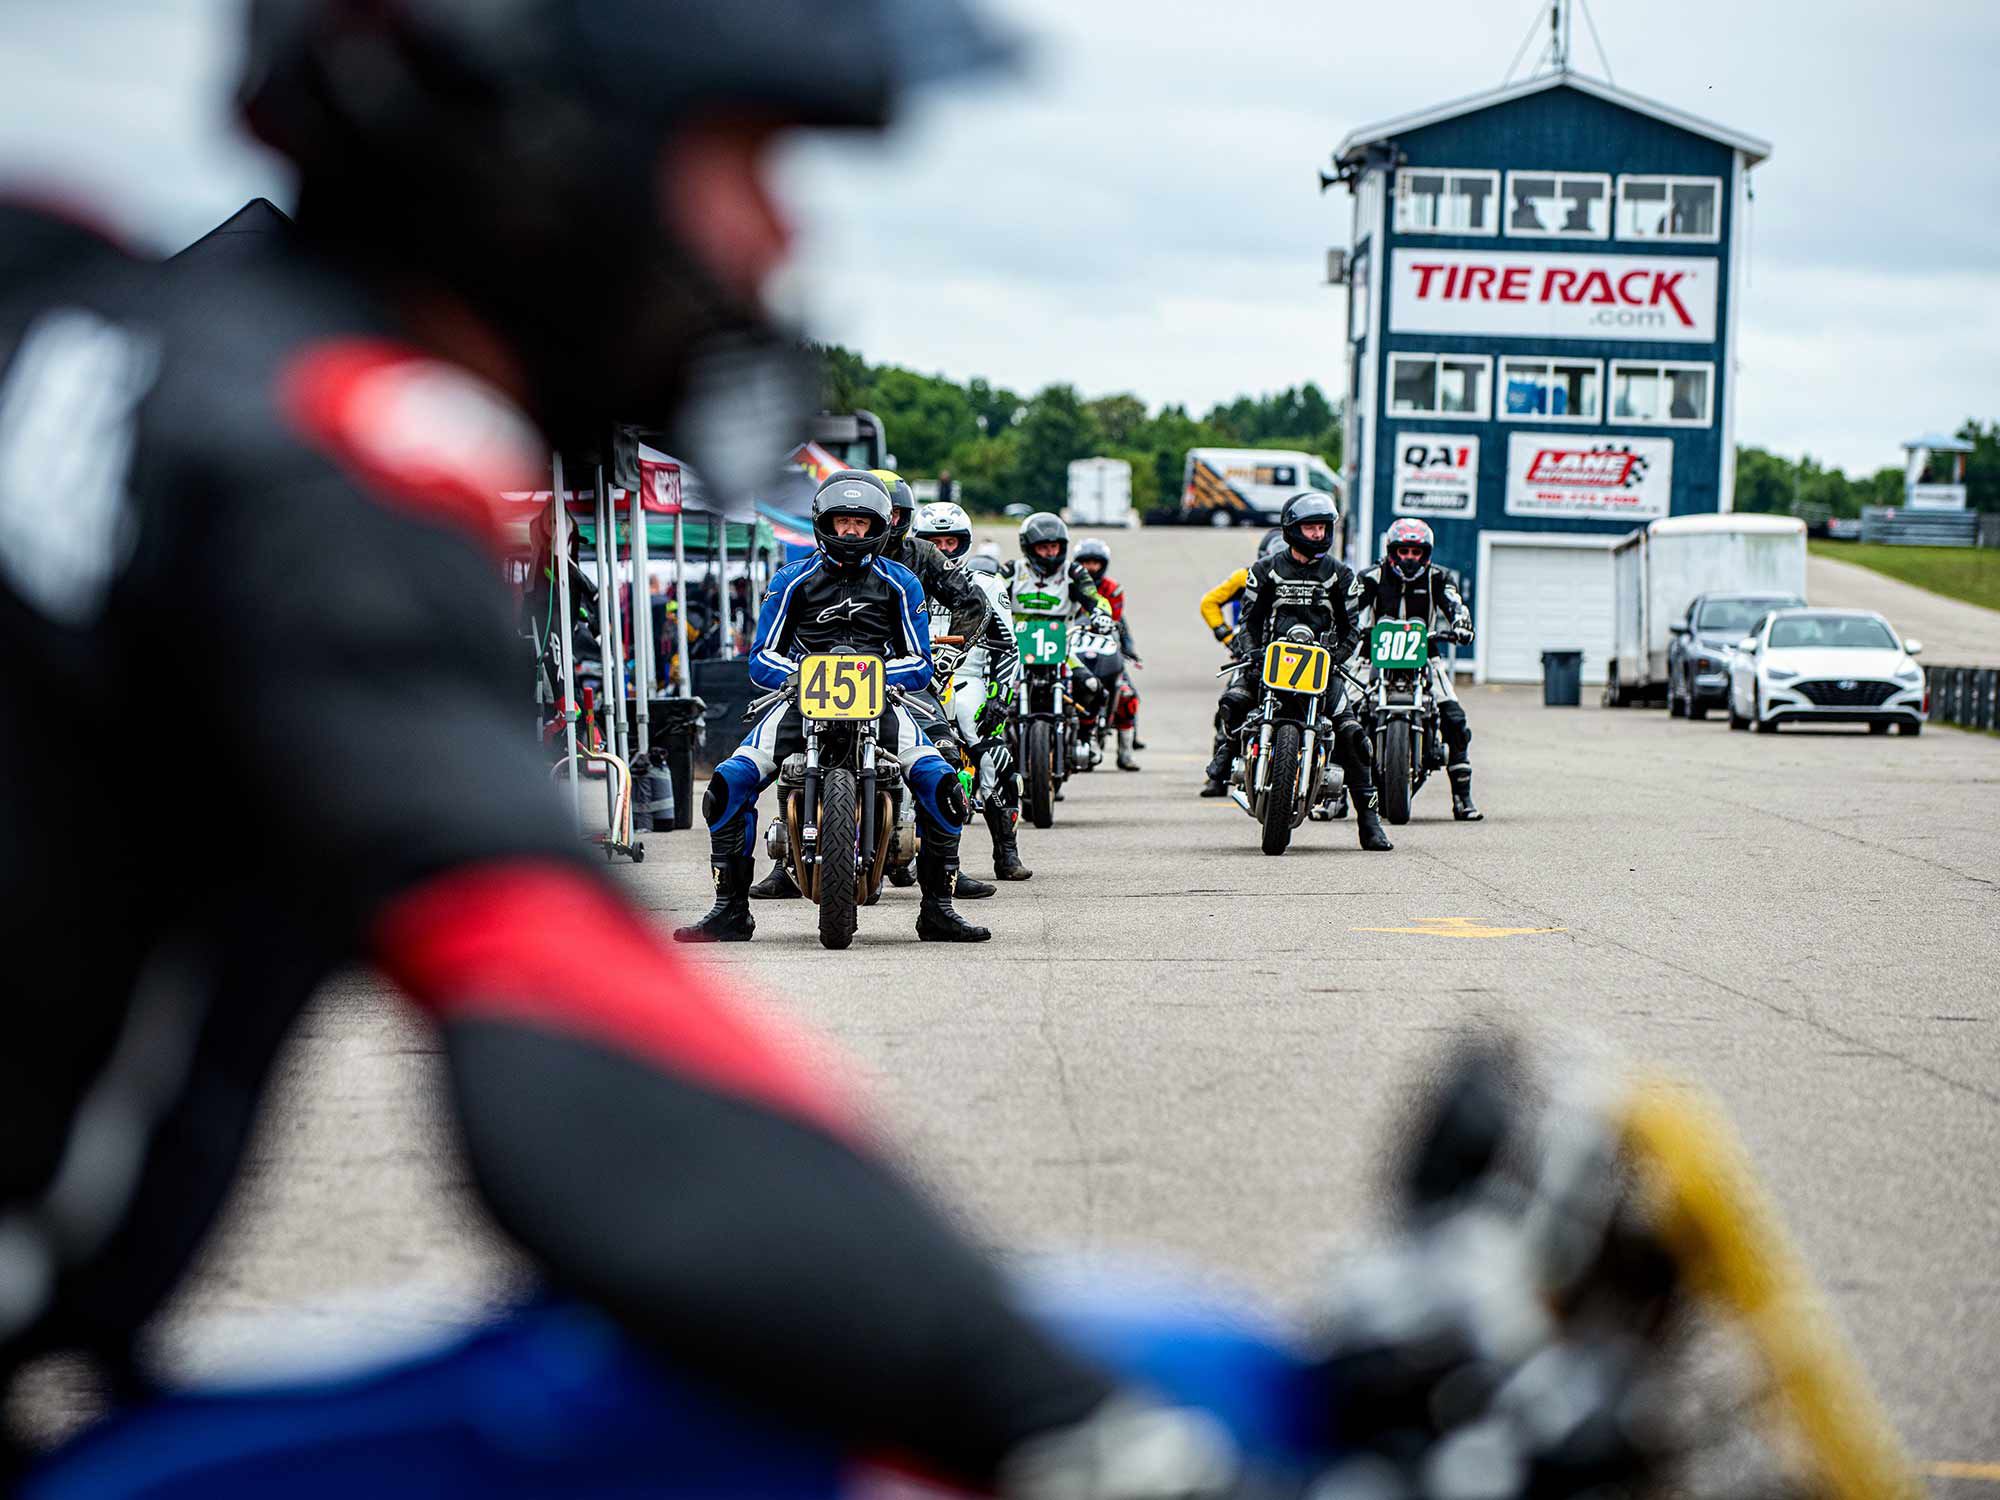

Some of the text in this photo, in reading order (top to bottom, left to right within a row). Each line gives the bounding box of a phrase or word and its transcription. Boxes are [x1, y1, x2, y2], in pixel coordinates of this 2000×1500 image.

[1410, 265, 1696, 328] TIRE RACK
[1589, 309, 1666, 328] .com
[1405, 446, 1470, 469] QA1
[1540, 452, 1627, 470] LANE
[1376, 630, 1421, 661] 302
[1269, 645, 1325, 690] 171
[805, 660, 877, 710] 451
